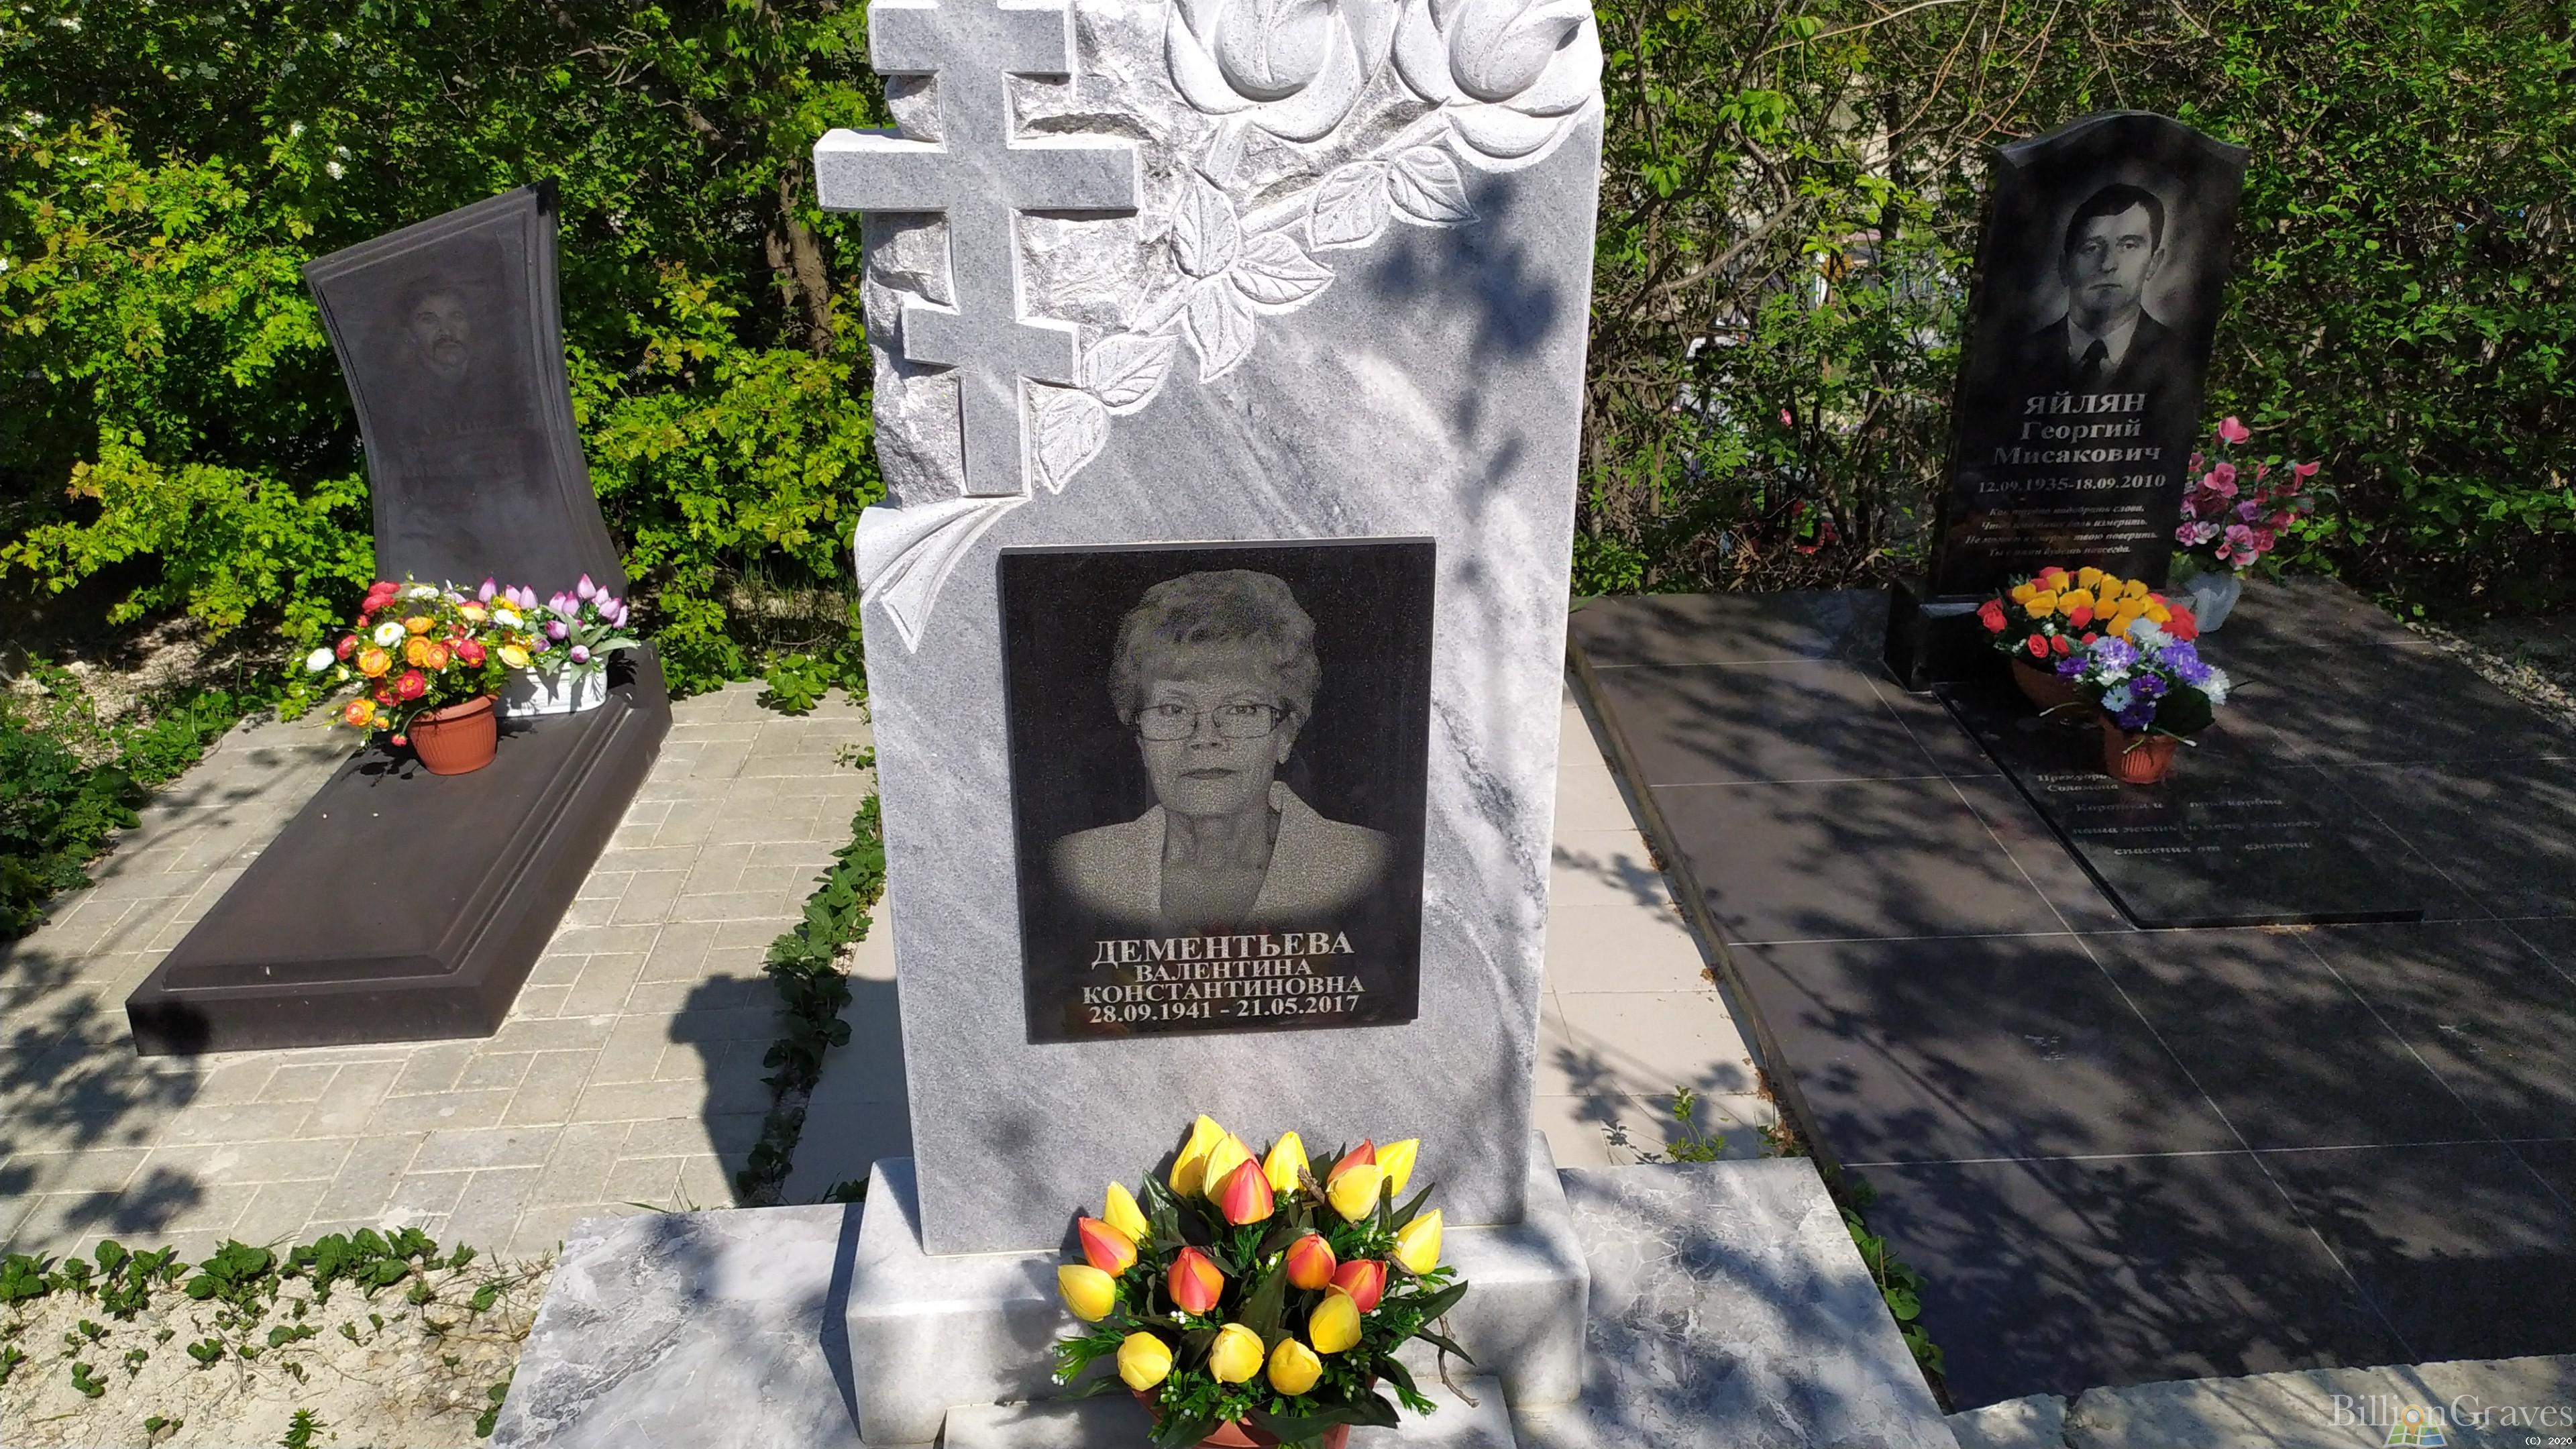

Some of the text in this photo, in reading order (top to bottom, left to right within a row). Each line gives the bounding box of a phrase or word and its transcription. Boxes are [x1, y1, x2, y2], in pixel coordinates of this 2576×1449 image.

[2024, 390, 2147, 415] ЯЙЛЯН
[2021, 418, 2141, 444] Георгий
[1993, 447, 2163, 464] Мисакович
[1978, 474, 2166, 493] 12.09.1935-18.09.2010
[2037, 773, 2111, 783] Премудро
[1091, 930, 1355, 969] ДЕМЕНТЬЕВА
[1134, 958, 1313, 982] ВАЛЕНТИНА
[1083, 975, 1366, 1004] КОНСТАНТИНОВНА
[1089, 1000, 1212, 1024] 28.09.1941
[1237, 995, 1359, 1017] 21.05.2017
